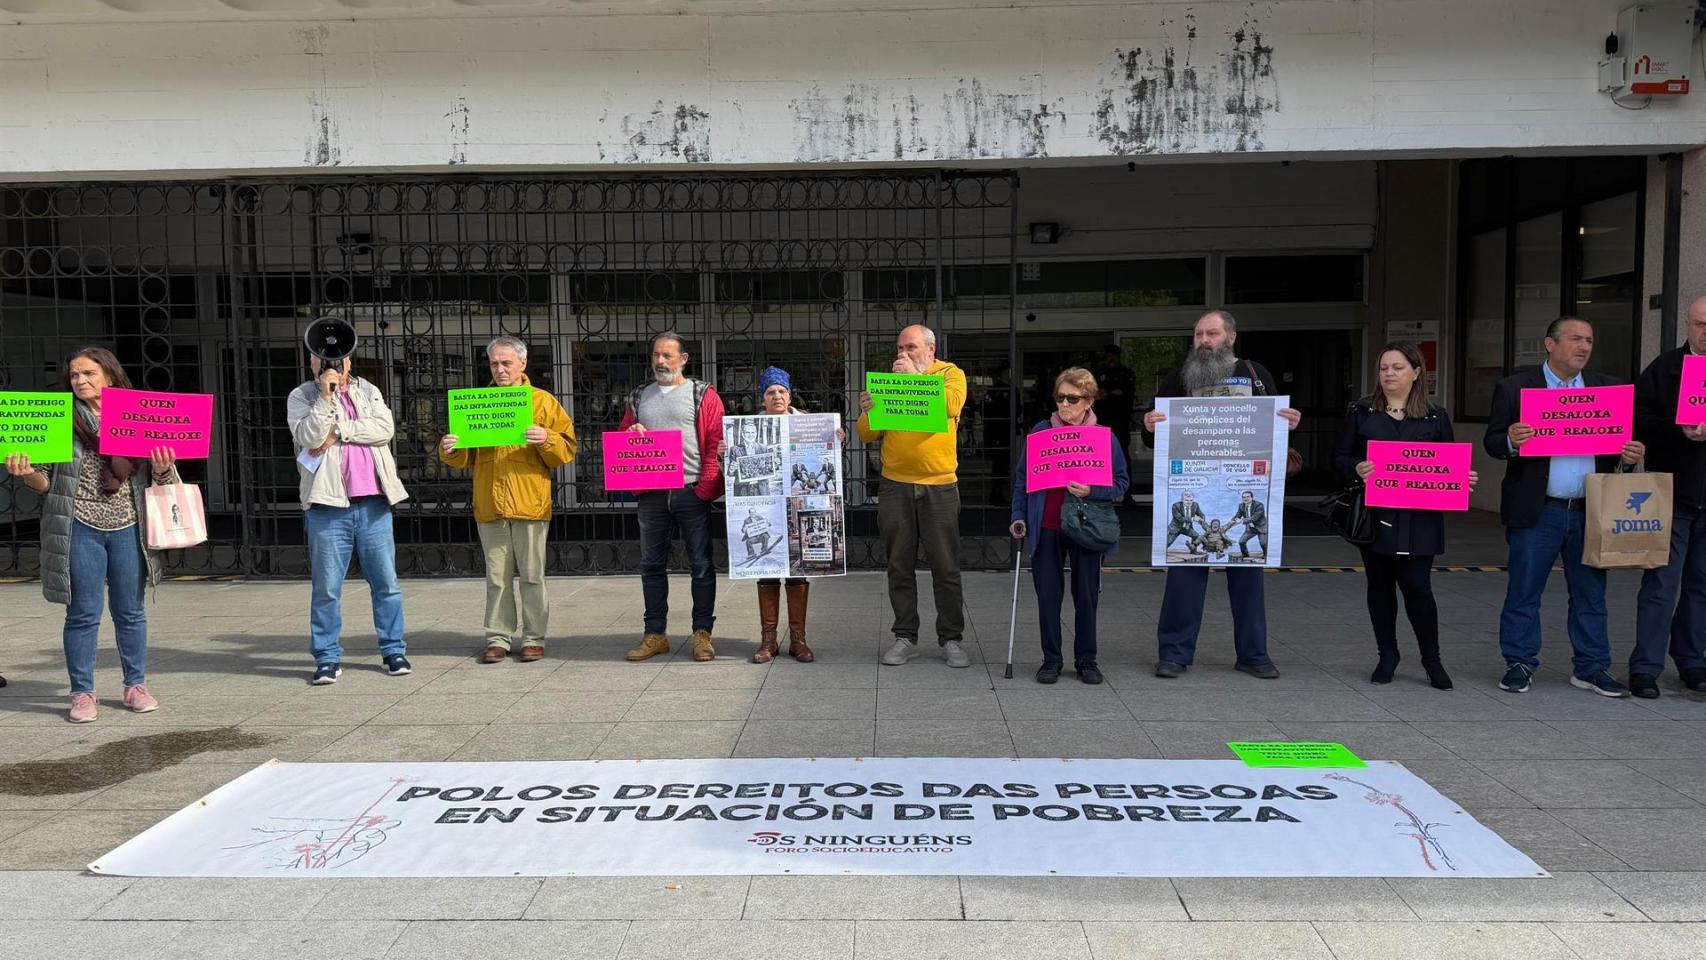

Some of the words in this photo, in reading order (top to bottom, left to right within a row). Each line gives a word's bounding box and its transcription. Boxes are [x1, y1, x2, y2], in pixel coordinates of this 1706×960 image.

[870, 378, 890, 386] BASTA
[884, 388, 940, 396] INFRAVIVENDAS
[139, 398, 176, 409] QUEN
[1558, 395, 1595, 405] QUEN
[470, 401, 528, 410] INFRAVIVENDAS
[1183, 405, 1208, 414] Xunta
[1211, 407, 1216, 415] y
[1218, 404, 1258, 413] concello
[122, 412, 192, 424] DESALOXA
[1542, 410, 1611, 420] DESALOXA
[1188, 416, 1234, 425] cómplices
[1236, 416, 1251, 424] del
[12, 423, 48, 432] DIGNO
[1182, 427, 1233, 436] desamparo
[1242, 426, 1256, 435] las
[1564, 426, 1624, 436] REALOXE
[109, 427, 137, 437] QUE
[144, 430, 202, 440] REALOXE
[1052, 432, 1080, 442] QUEN
[9, 435, 46, 443] TODAS
[627, 437, 654, 446] QUEN
[1198, 438, 1240, 447] personas
[617, 450, 667, 459] DESALOXA
[1040, 446, 1094, 457] DESALOXA
[1190, 448, 1246, 457] vulnerables.
[1402, 449, 1436, 458] QUEN
[610, 465, 628, 474] QUE
[633, 463, 678, 472] REALOXE
[1033, 464, 1051, 474] QUE
[1056, 460, 1104, 468] REALOXE
[1386, 464, 1450, 474] DESALOXA
[1375, 479, 1398, 488] QUE
[1406, 480, 1461, 490] REALOXE
[397, 784, 601, 802] POLOS
[611, 783, 904, 800] DEREITOS
[922, 782, 1040, 799] DAS
[1053, 783, 1340, 800] PERSOAS
[434, 806, 525, 824] EN
[535, 799, 874, 823] SITUACIÓN
[893, 804, 975, 821] DE
[993, 804, 1303, 823] POBREZA
[805, 833, 973, 846] NINGUÉNS
[764, 846, 809, 854] FORO
[811, 846, 954, 854] SOCIOEDUCATIVO
